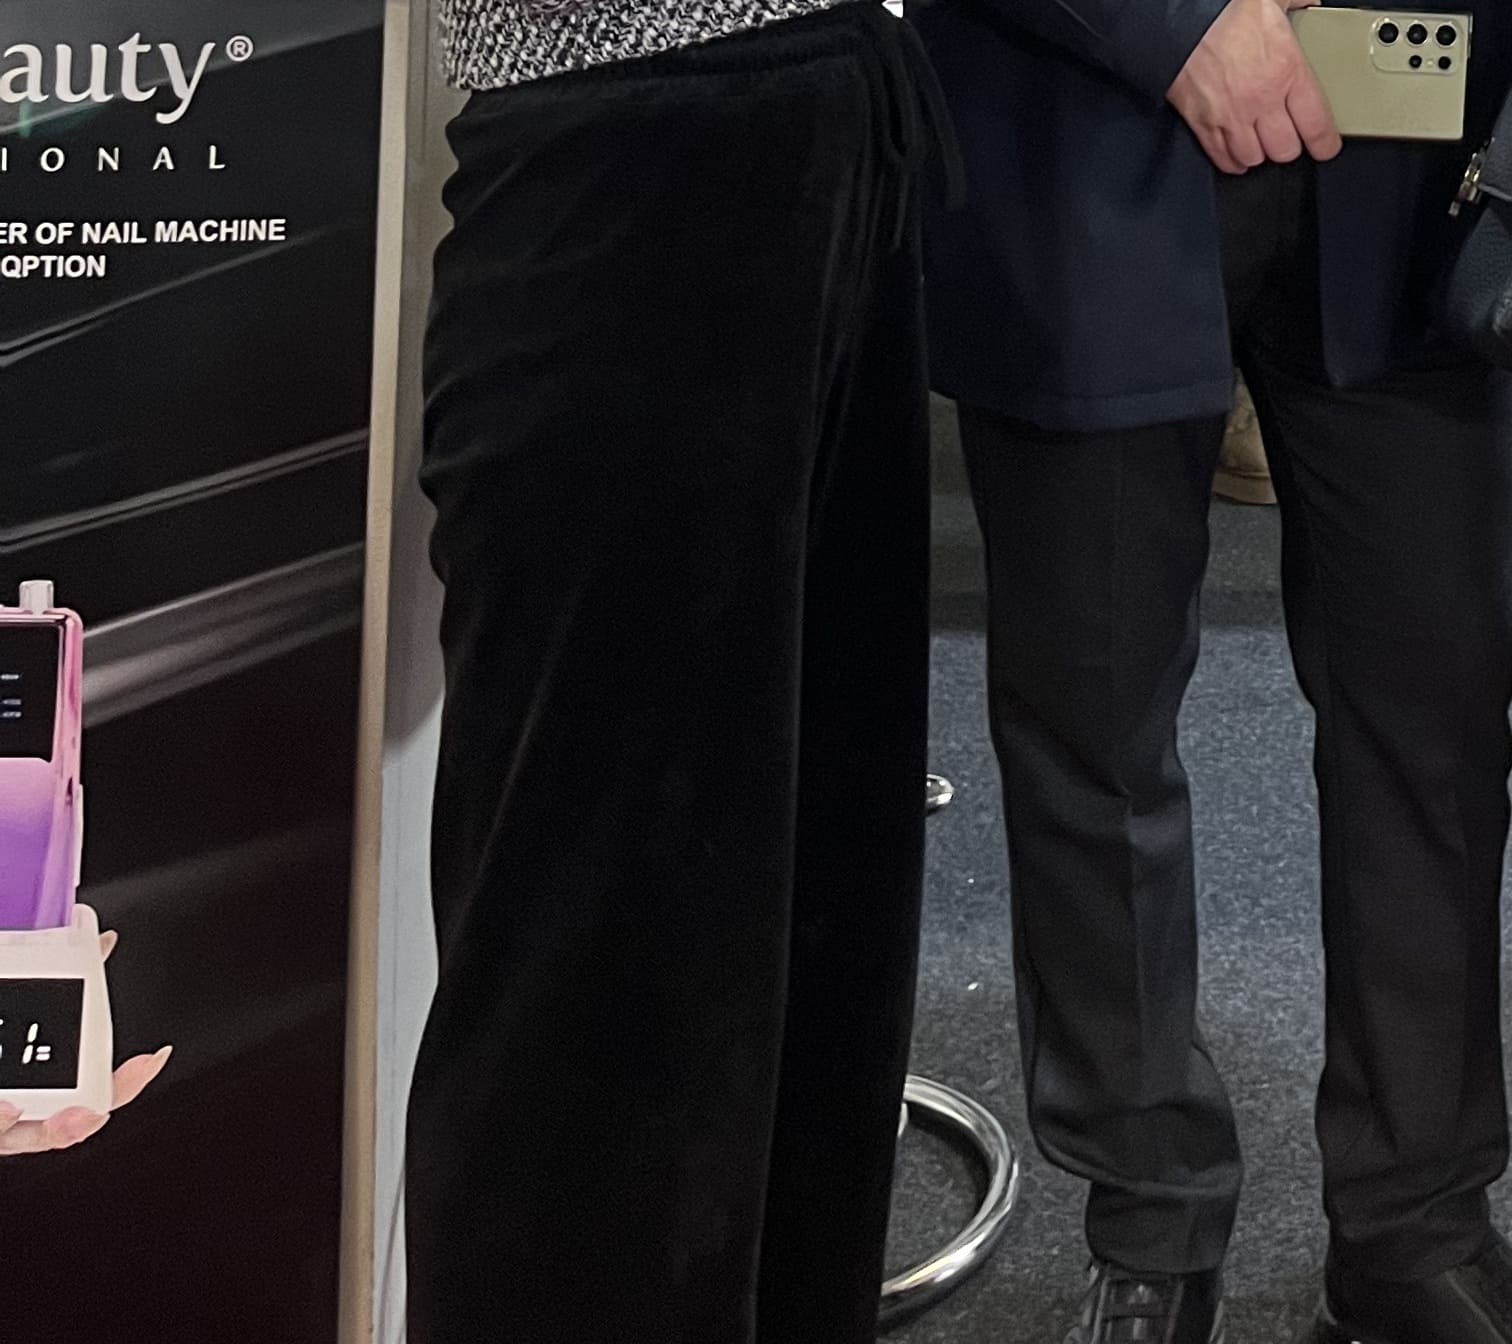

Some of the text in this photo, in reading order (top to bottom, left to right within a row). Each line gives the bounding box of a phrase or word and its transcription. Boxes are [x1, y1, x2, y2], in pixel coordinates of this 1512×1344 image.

[35, 222, 75, 245] OF
[81, 221, 148, 244] NAIL
[154, 218, 287, 243] MACHINE
